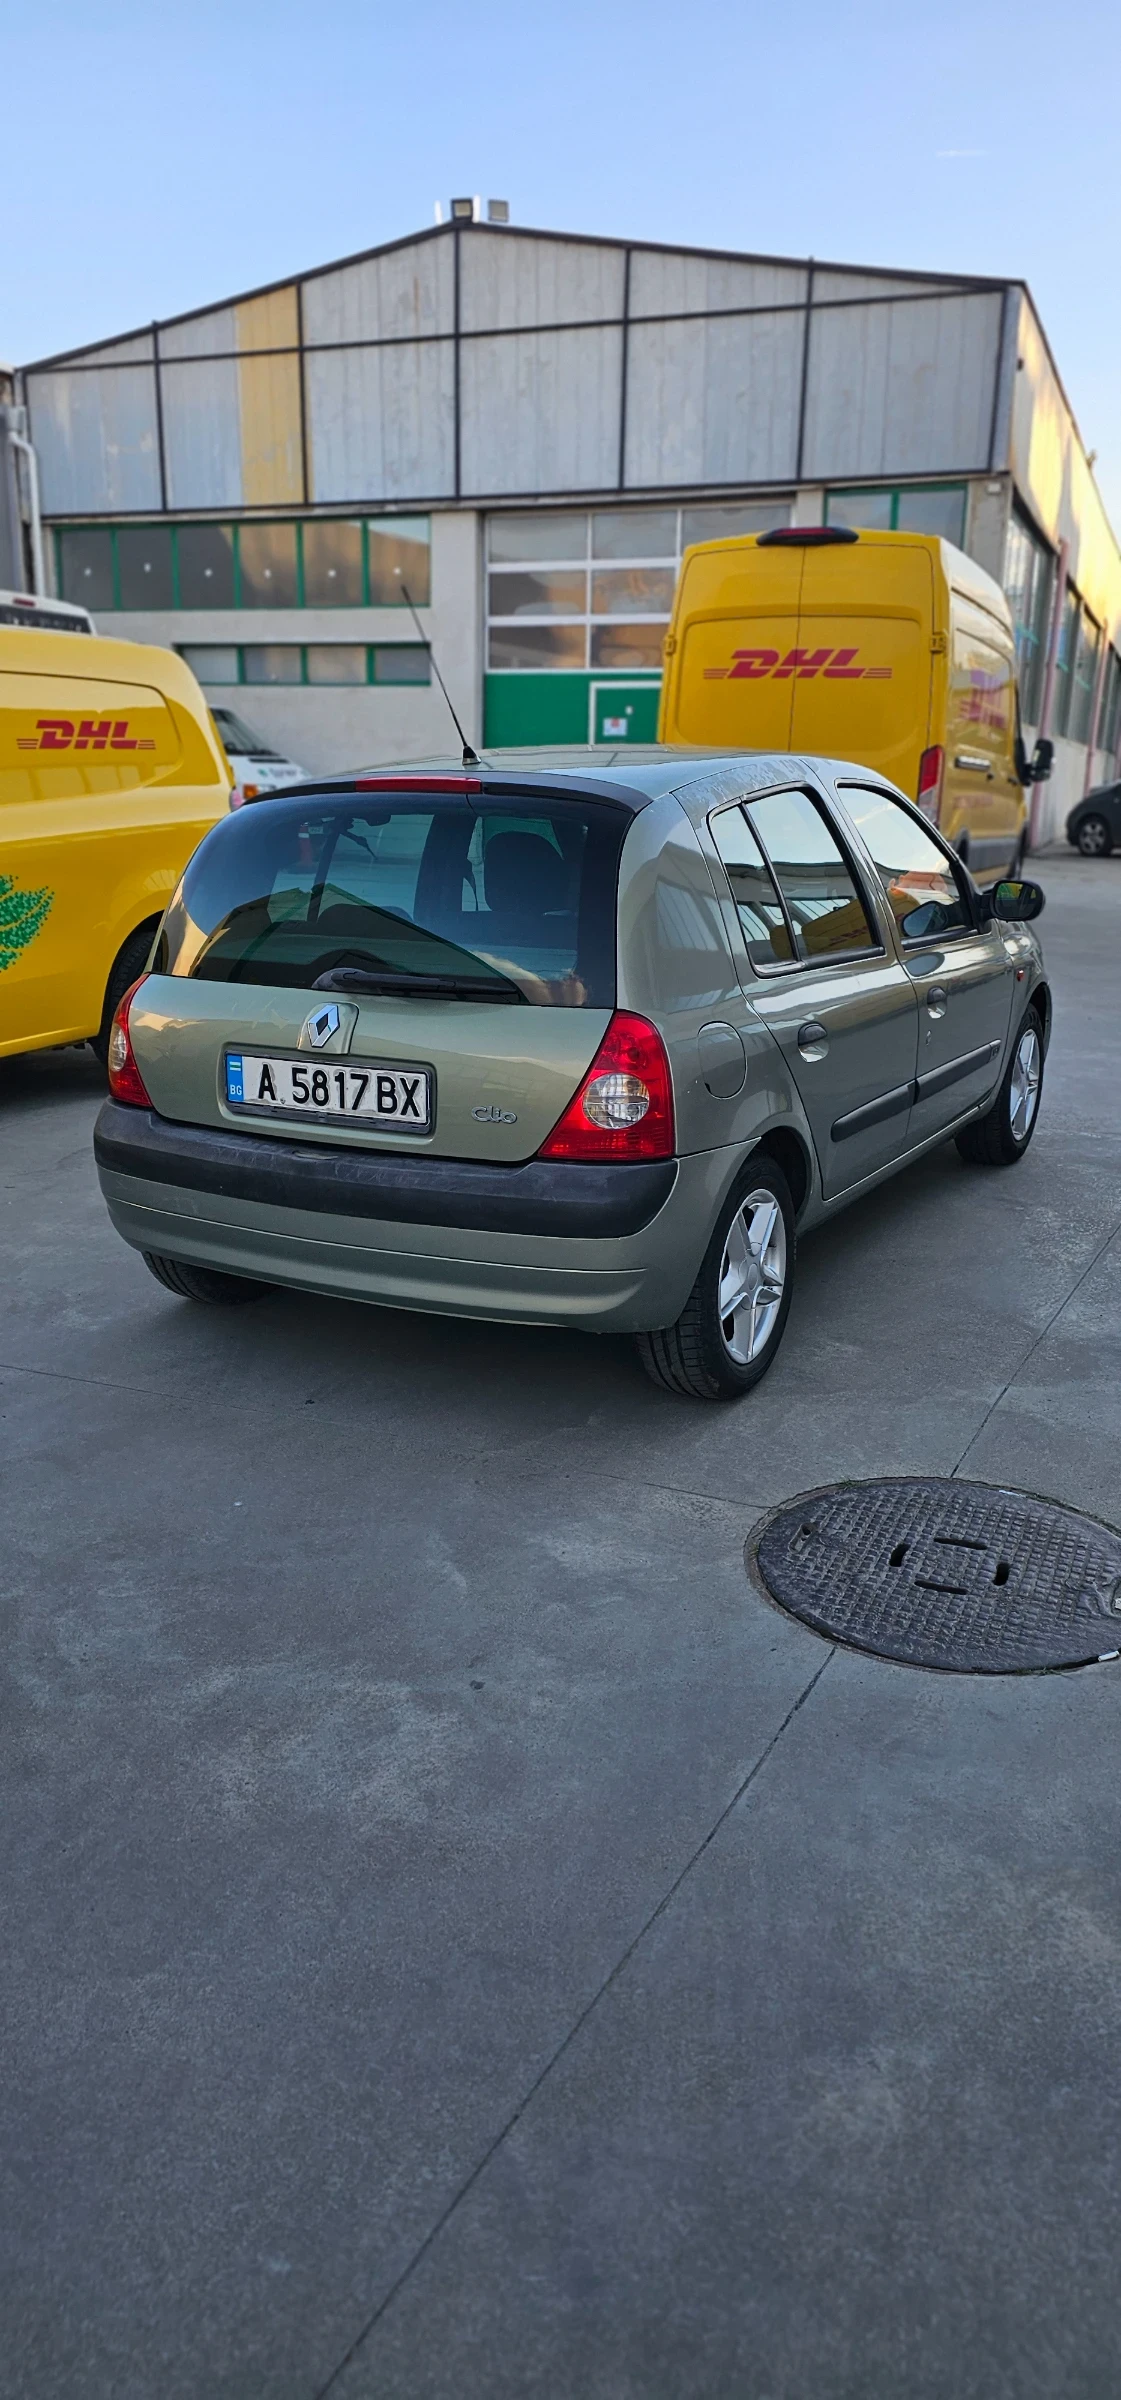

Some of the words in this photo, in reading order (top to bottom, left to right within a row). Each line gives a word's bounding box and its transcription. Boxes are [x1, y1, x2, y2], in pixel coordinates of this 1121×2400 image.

[727, 648, 866, 678] DHL
[36, 719, 138, 750] DHL
[229, 1084, 243, 1097] BG
[471, 1105, 517, 1124] Clio
